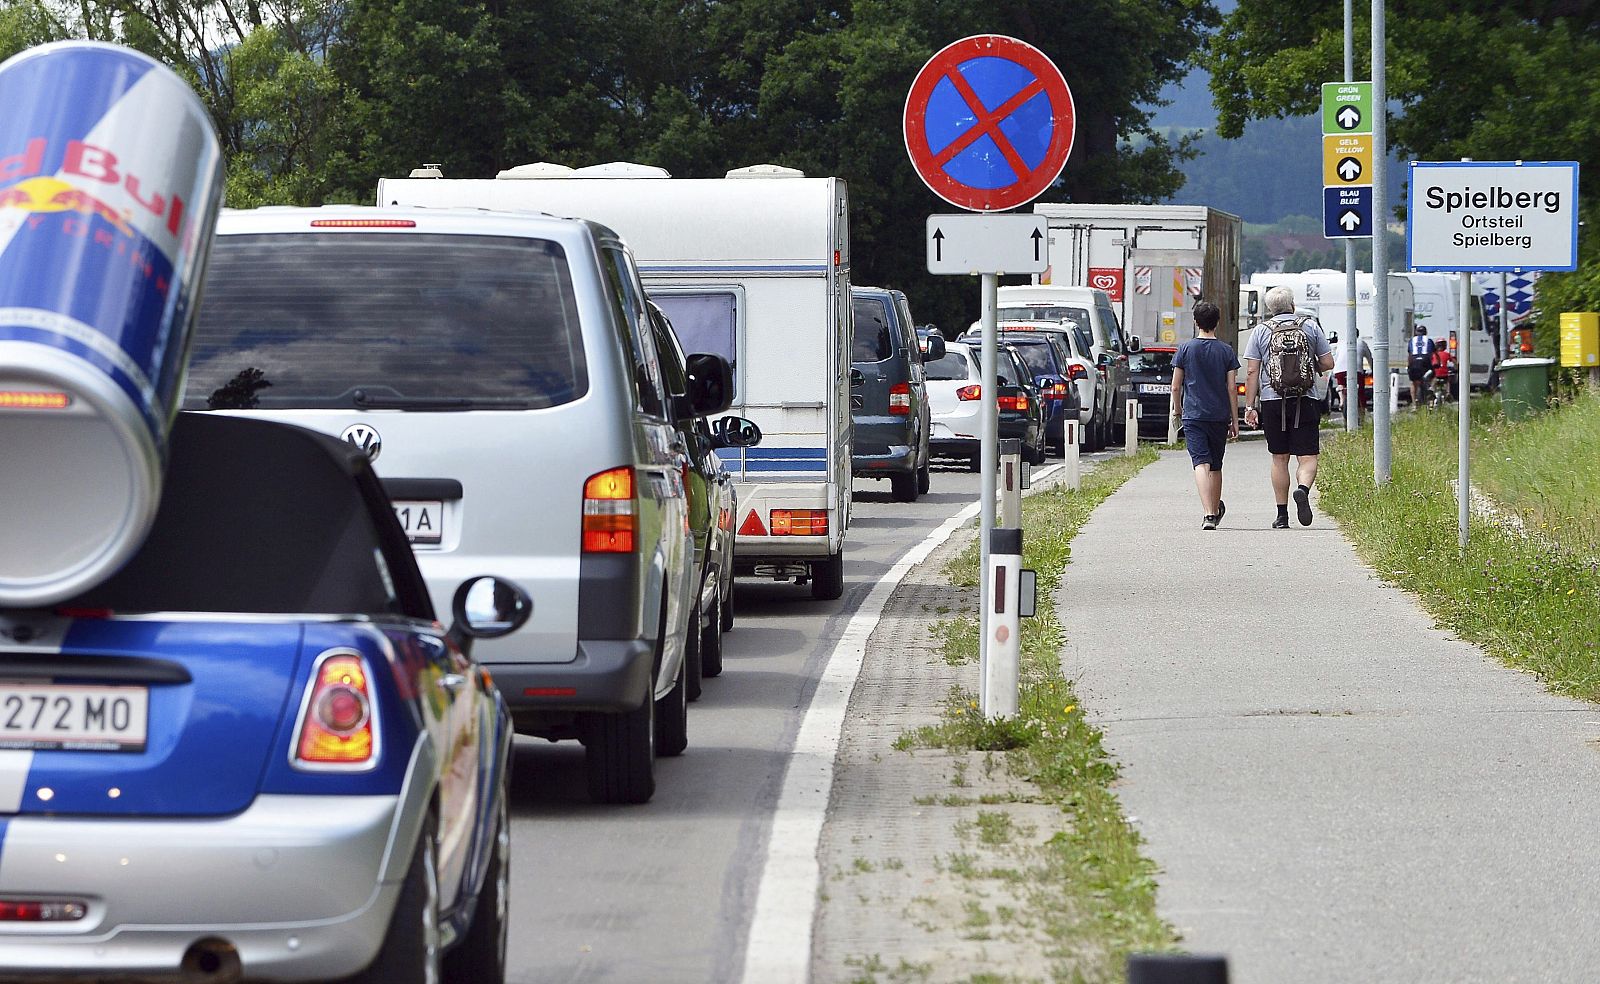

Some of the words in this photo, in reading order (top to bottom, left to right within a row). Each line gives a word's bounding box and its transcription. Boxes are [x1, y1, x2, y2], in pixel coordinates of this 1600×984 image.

[1337, 85, 1359, 94] GRÜN
[1335, 94, 1362, 102] GREEN
[1339, 138, 1359, 146] GELB
[1335, 146, 1365, 154] YELLOW
[1426, 186, 1560, 214] Spielberg
[1461, 214, 1523, 229] Ortsteil
[1453, 232, 1532, 249] Spielberg
[5, 695, 71, 730] 272
[84, 697, 130, 732] MO
